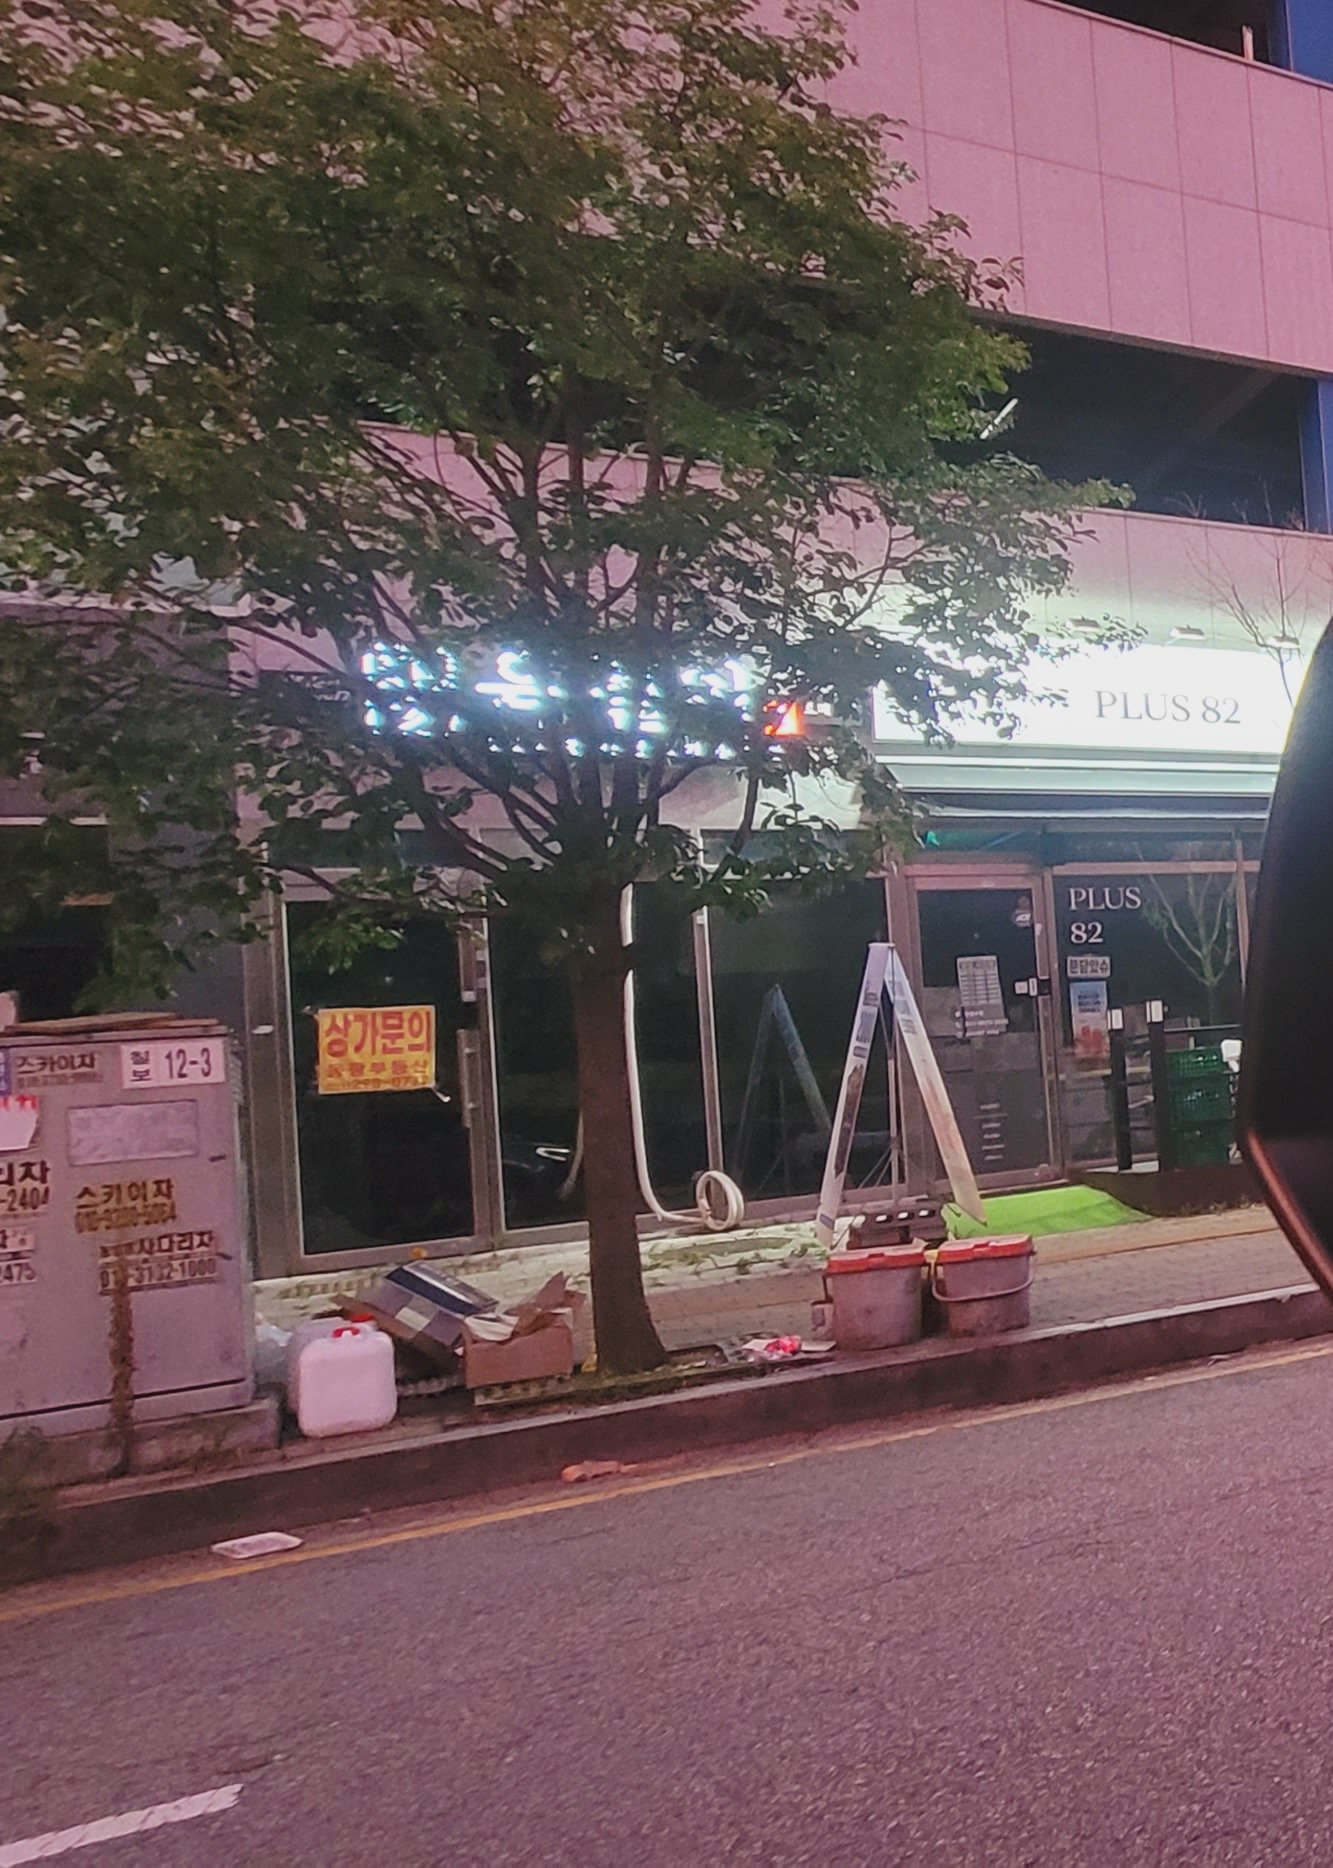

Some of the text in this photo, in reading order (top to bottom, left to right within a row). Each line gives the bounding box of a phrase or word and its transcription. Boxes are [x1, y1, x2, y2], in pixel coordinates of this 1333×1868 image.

[1095, 689, 1241, 724] PLUS 82
[1069, 886, 1142, 910] PLUS
[1071, 921, 1104, 944] 82
[325, 1011, 432, 1058] 상가문의
[165, 1047, 212, 1079] 12-3
